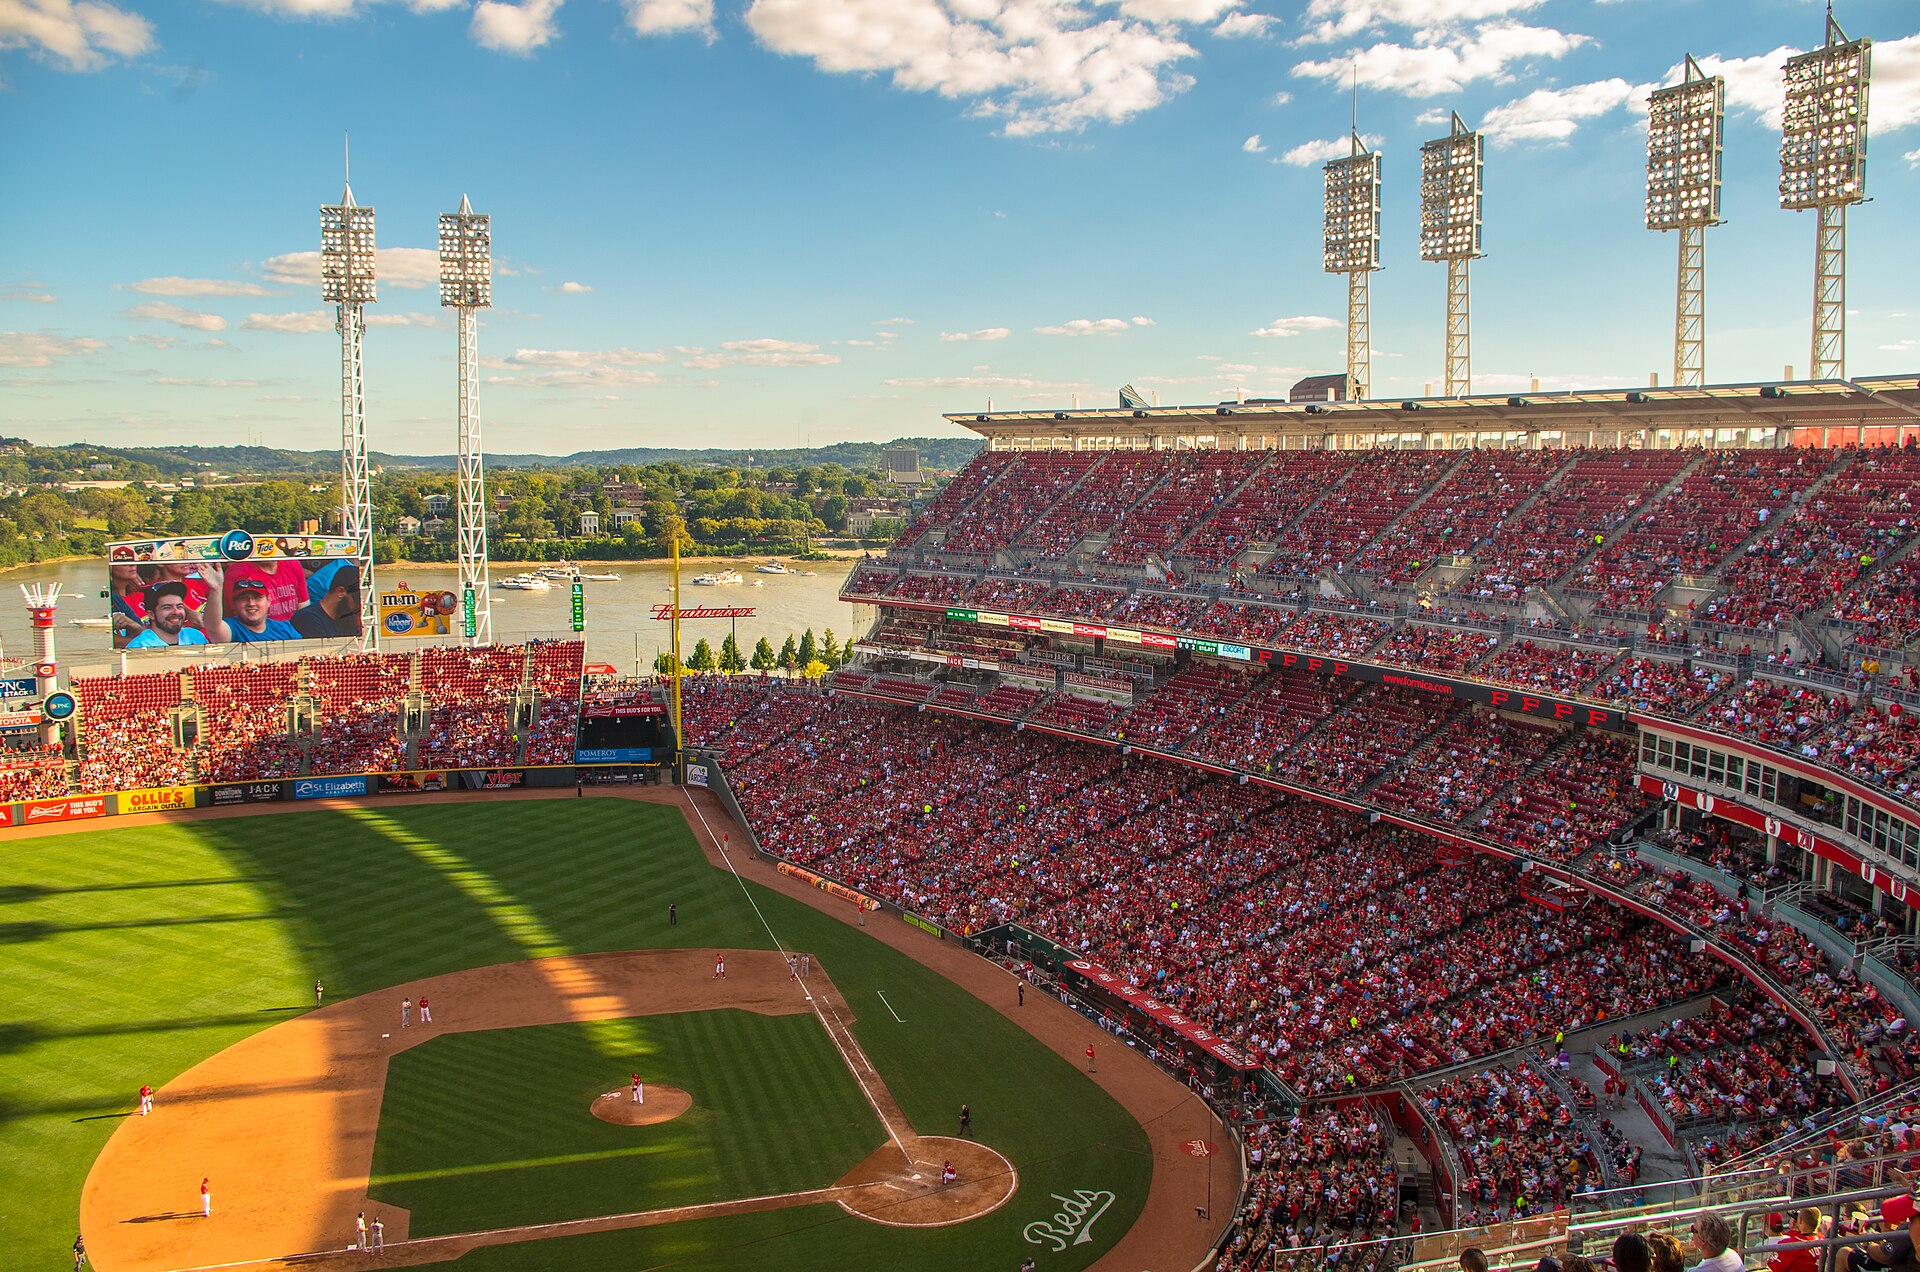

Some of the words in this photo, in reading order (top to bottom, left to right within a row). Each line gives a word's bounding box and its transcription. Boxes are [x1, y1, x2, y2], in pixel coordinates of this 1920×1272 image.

[227, 540, 251, 551] P&G
[256, 543, 274, 554] Tide
[947, 657, 962, 666] JACK
[1258, 650, 1273, 663] F
[1283, 654, 1298, 667] F
[1308, 658, 1323, 671] F
[1333, 662, 1349, 675] F
[1065, 672, 1084, 683] JACK
[1084, 676, 1112, 687] CINCINNATI
[1112, 679, 1131, 691] CASINO
[1383, 674, 1453, 695] www.formica.com
[1490, 690, 1509, 706] F
[1522, 696, 1540, 712] F
[1554, 703, 1573, 719] F
[1588, 709, 1608, 725] F
[0, 717, 32, 726] TOYOTA
[579, 749, 617, 757] POMEROY
[313, 783, 323, 792] St.
[325, 780, 365, 791] Elizabeth
[214, 789, 242, 797] DOWNTOWN
[128, 804, 159, 812] BARGAIN
[161, 802, 187, 810] OUTLET
[1022, 1189, 1116, 1252] Reds
